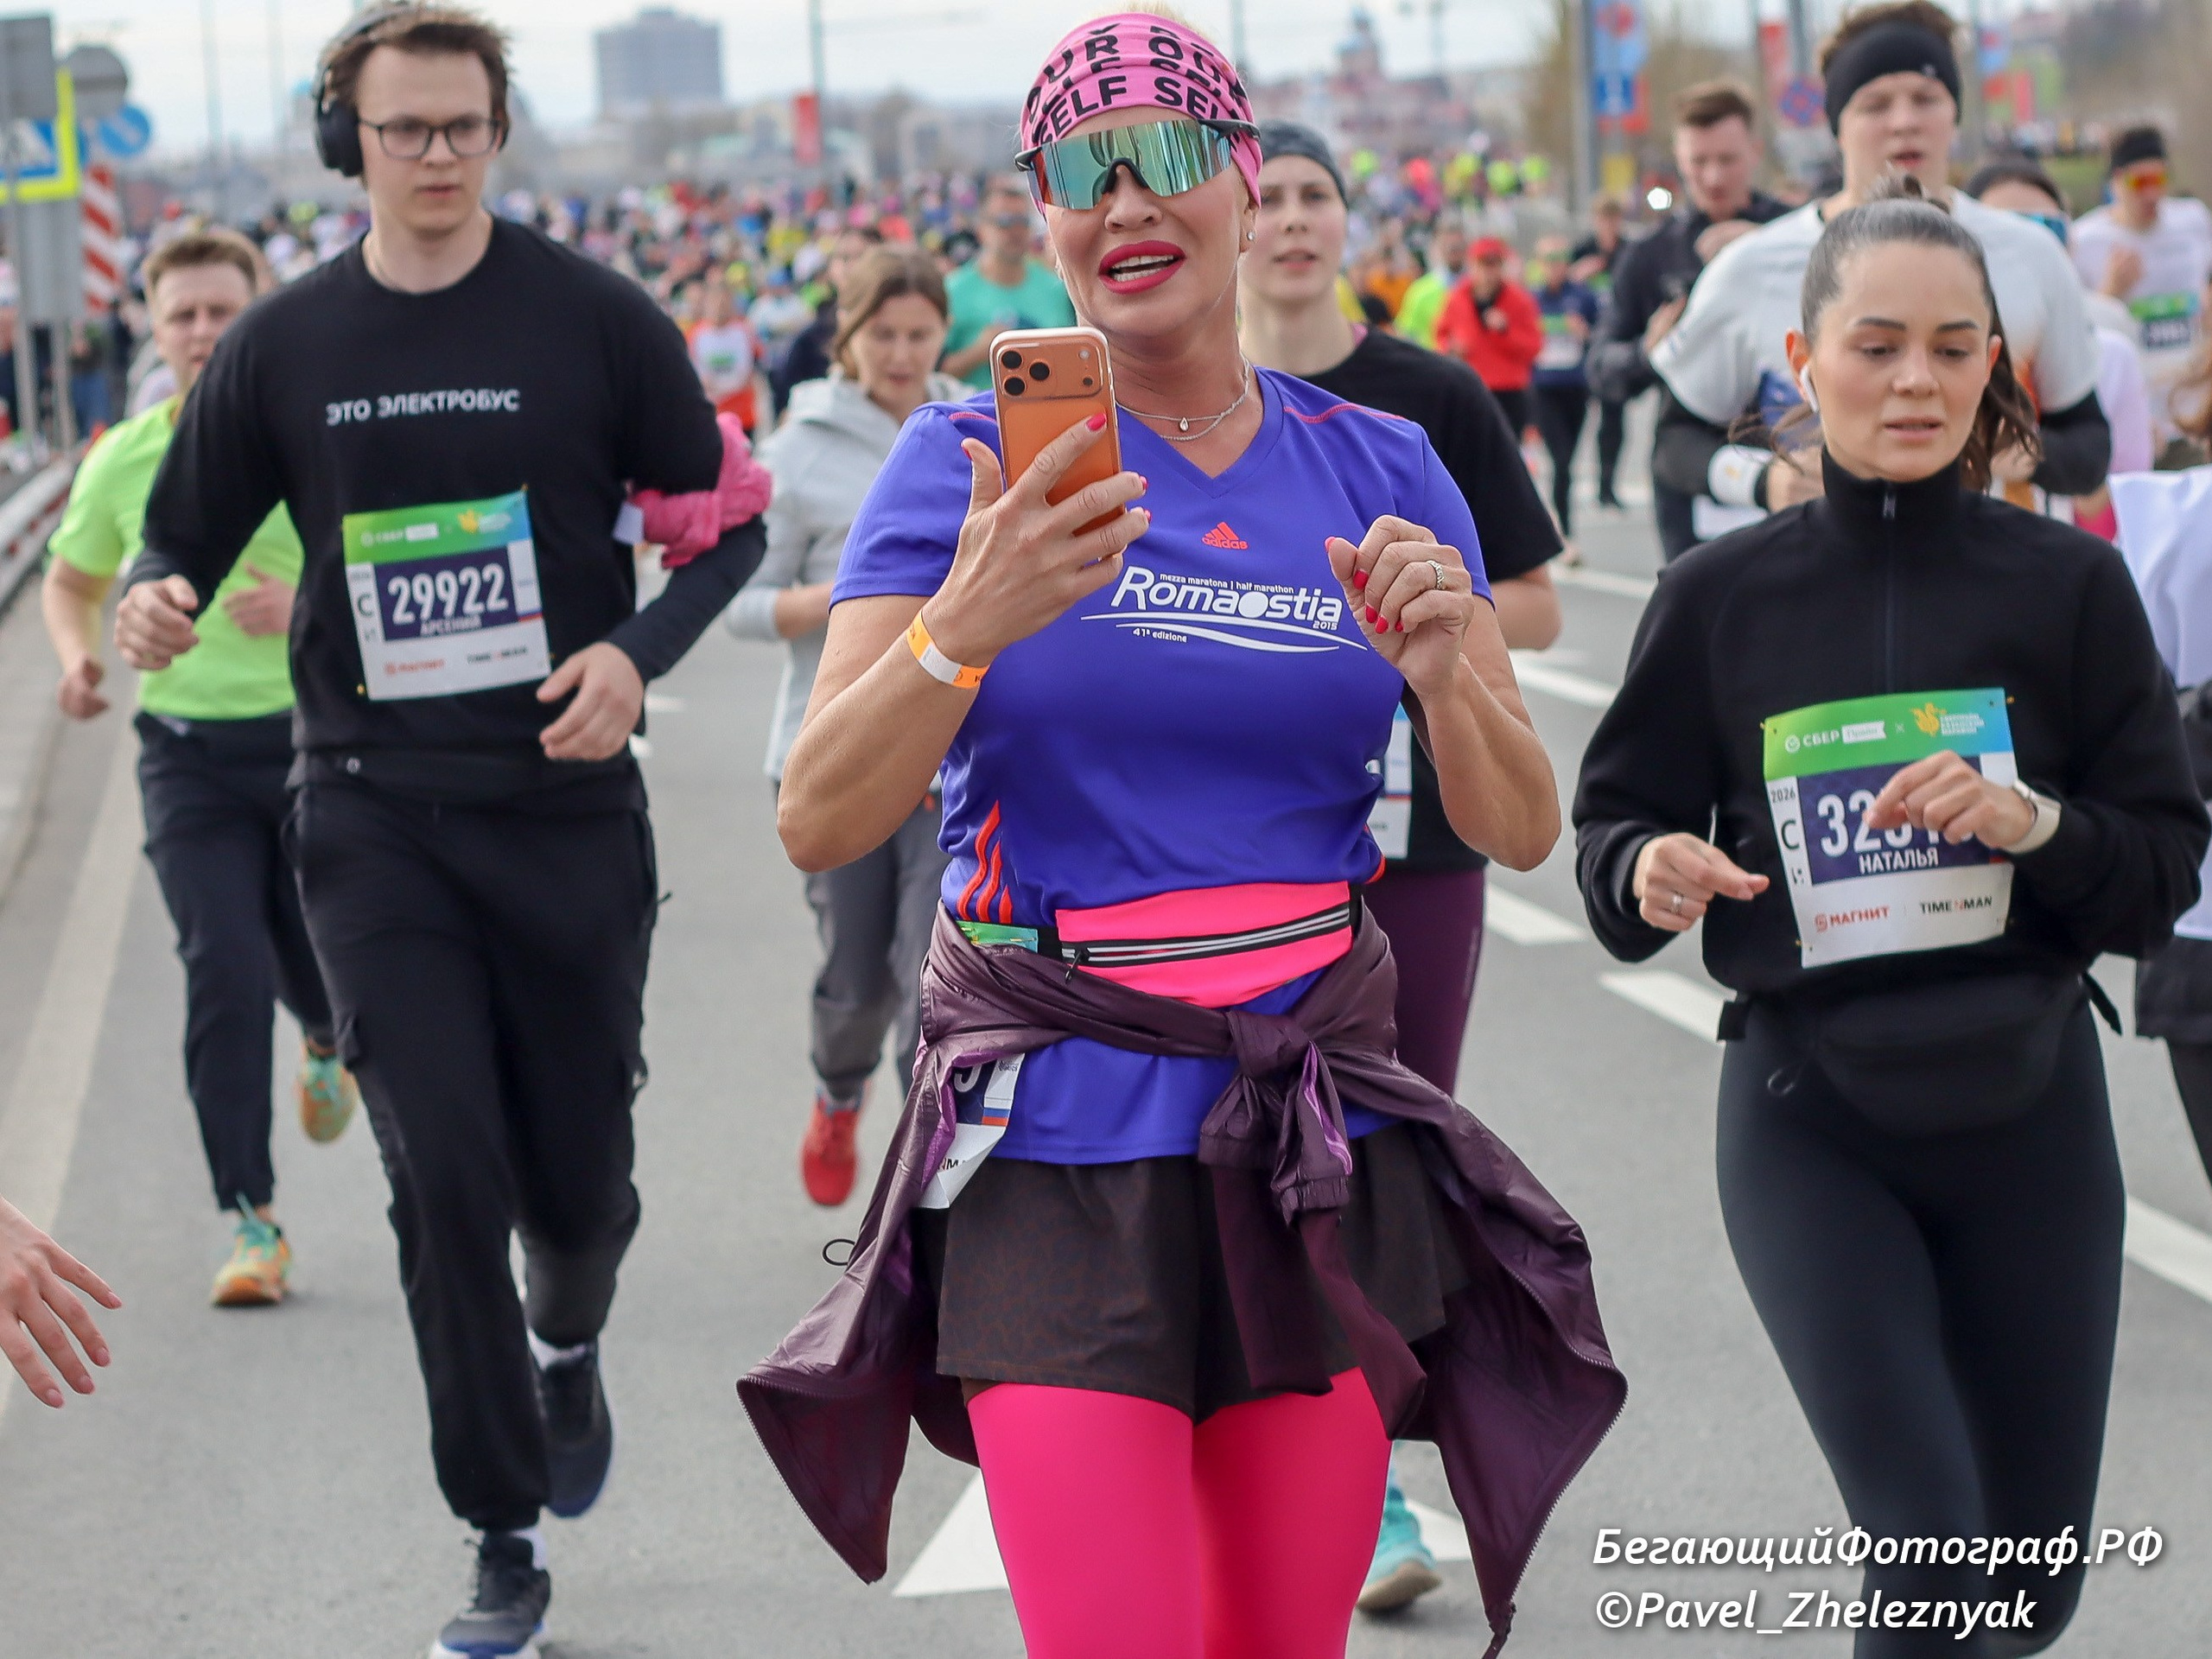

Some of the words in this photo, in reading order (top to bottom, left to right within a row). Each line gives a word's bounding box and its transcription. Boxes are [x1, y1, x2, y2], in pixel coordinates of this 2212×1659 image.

[326, 398, 372, 426] ЭТО
[377, 389, 520, 418] ЭЛЕКТРОБУС
[1202, 537, 1248, 550] adidas
[1160, 573, 1186, 584] mezza
[1188, 575, 1228, 588] maratona
[1236, 581, 1253, 592] half
[1254, 584, 1294, 594] marathon
[388, 563, 509, 626] 29922
[1313, 620, 1338, 631] 2015
[1152, 631, 1187, 643] edizione
[1771, 786, 1796, 804] 2026
[1859, 848, 1939, 874] НАТАЛЬЯ
[1829, 906, 1890, 925] МАГНИТ
